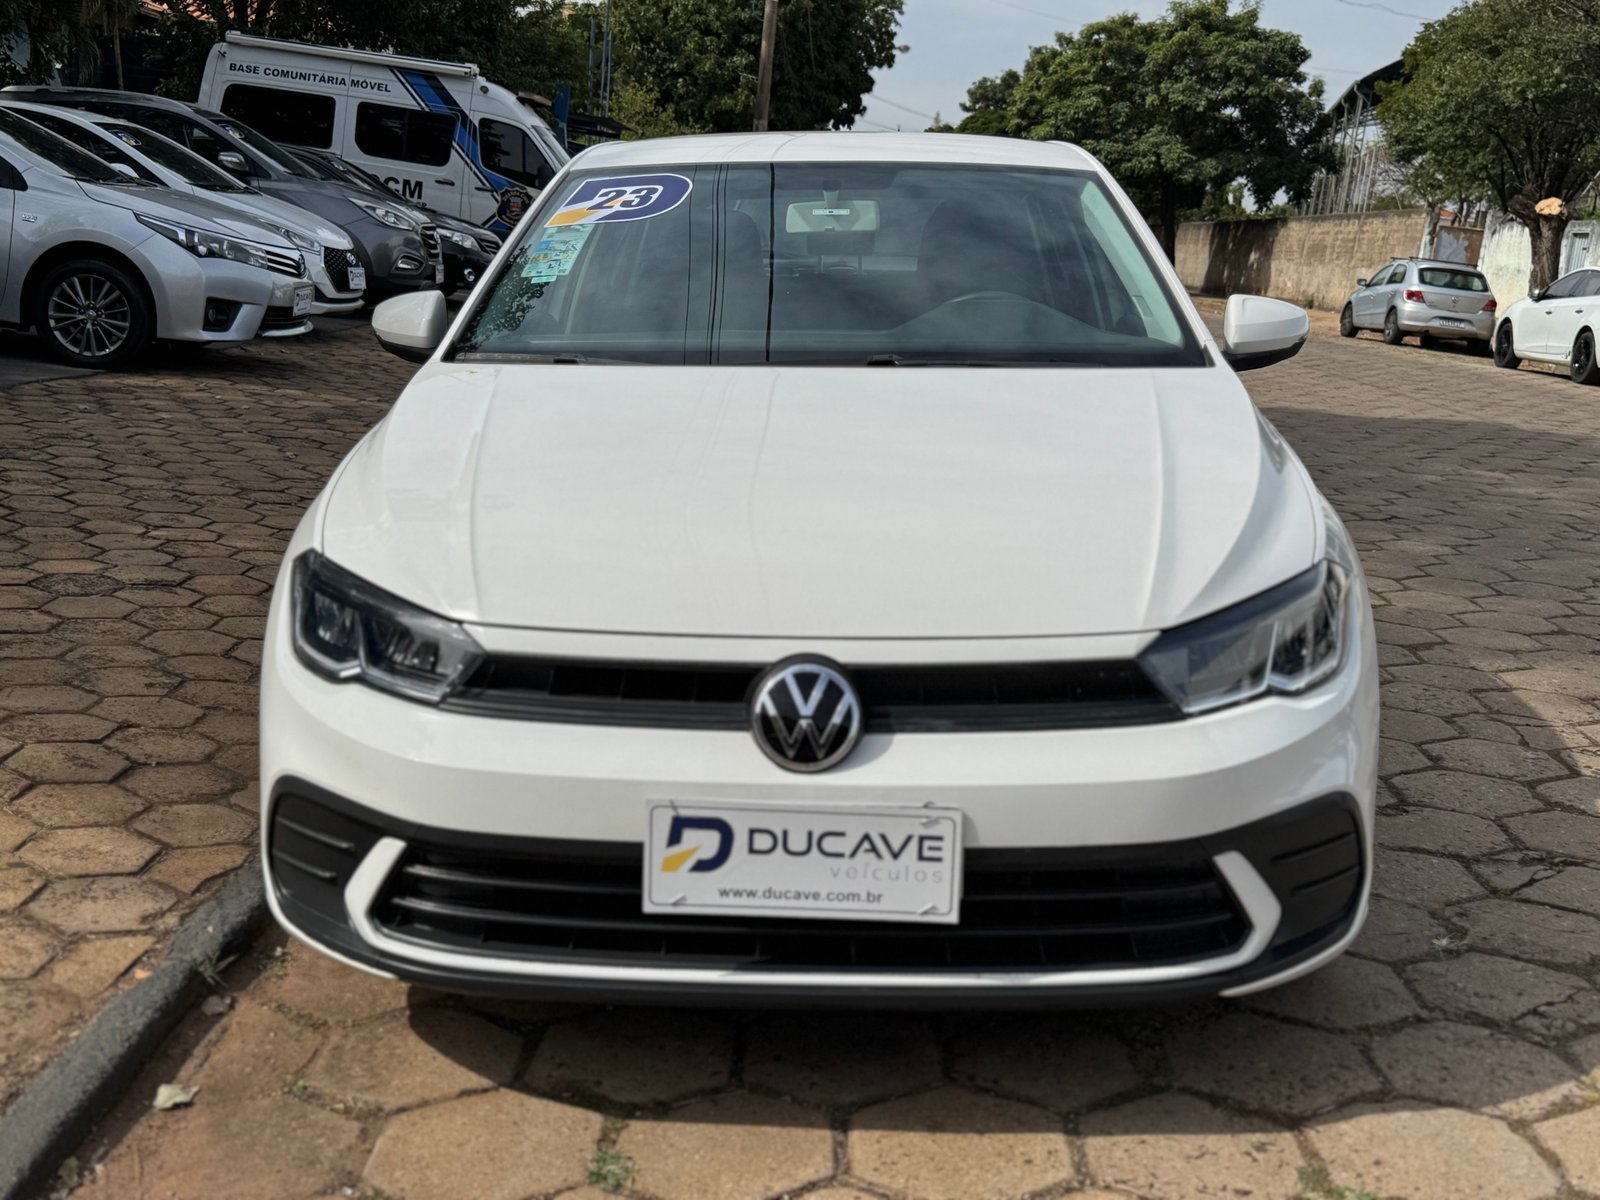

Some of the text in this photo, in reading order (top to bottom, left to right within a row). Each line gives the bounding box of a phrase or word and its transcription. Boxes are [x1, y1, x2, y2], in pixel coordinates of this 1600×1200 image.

[229, 63, 392, 93] BASE COMUNITÁRIA MÓVEL
[370, 173, 423, 200] CM
[586, 187, 654, 211] 23
[748, 828, 944, 862] DUCAVE
[829, 862, 944, 884] veículos
[718, 885, 883, 904] www.ducave.com.br
